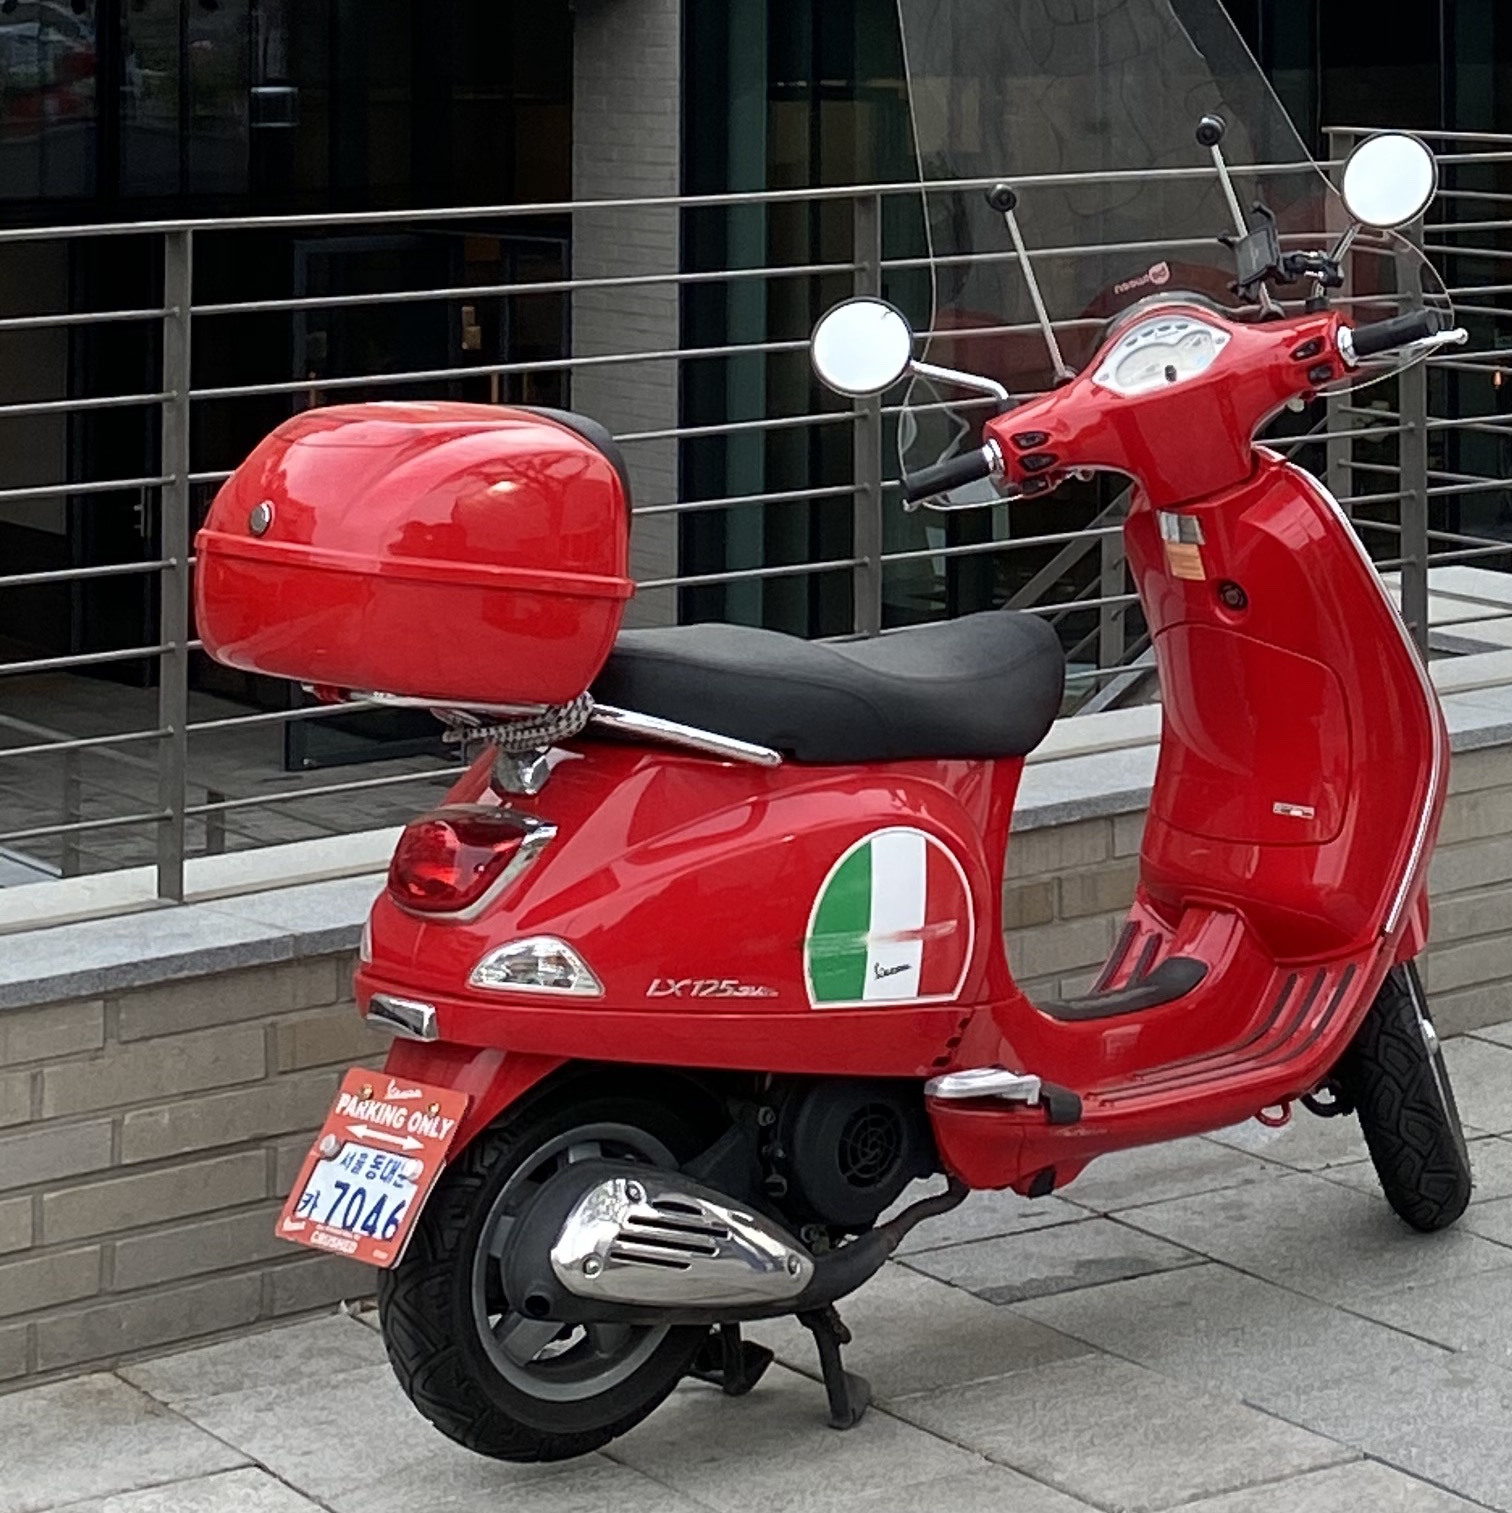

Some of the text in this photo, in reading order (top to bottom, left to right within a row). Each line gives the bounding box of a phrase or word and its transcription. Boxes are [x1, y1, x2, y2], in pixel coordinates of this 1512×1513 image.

[335, 1092, 455, 1141] PARKING ONLY
[298, 1180, 406, 1241] 카 7046
